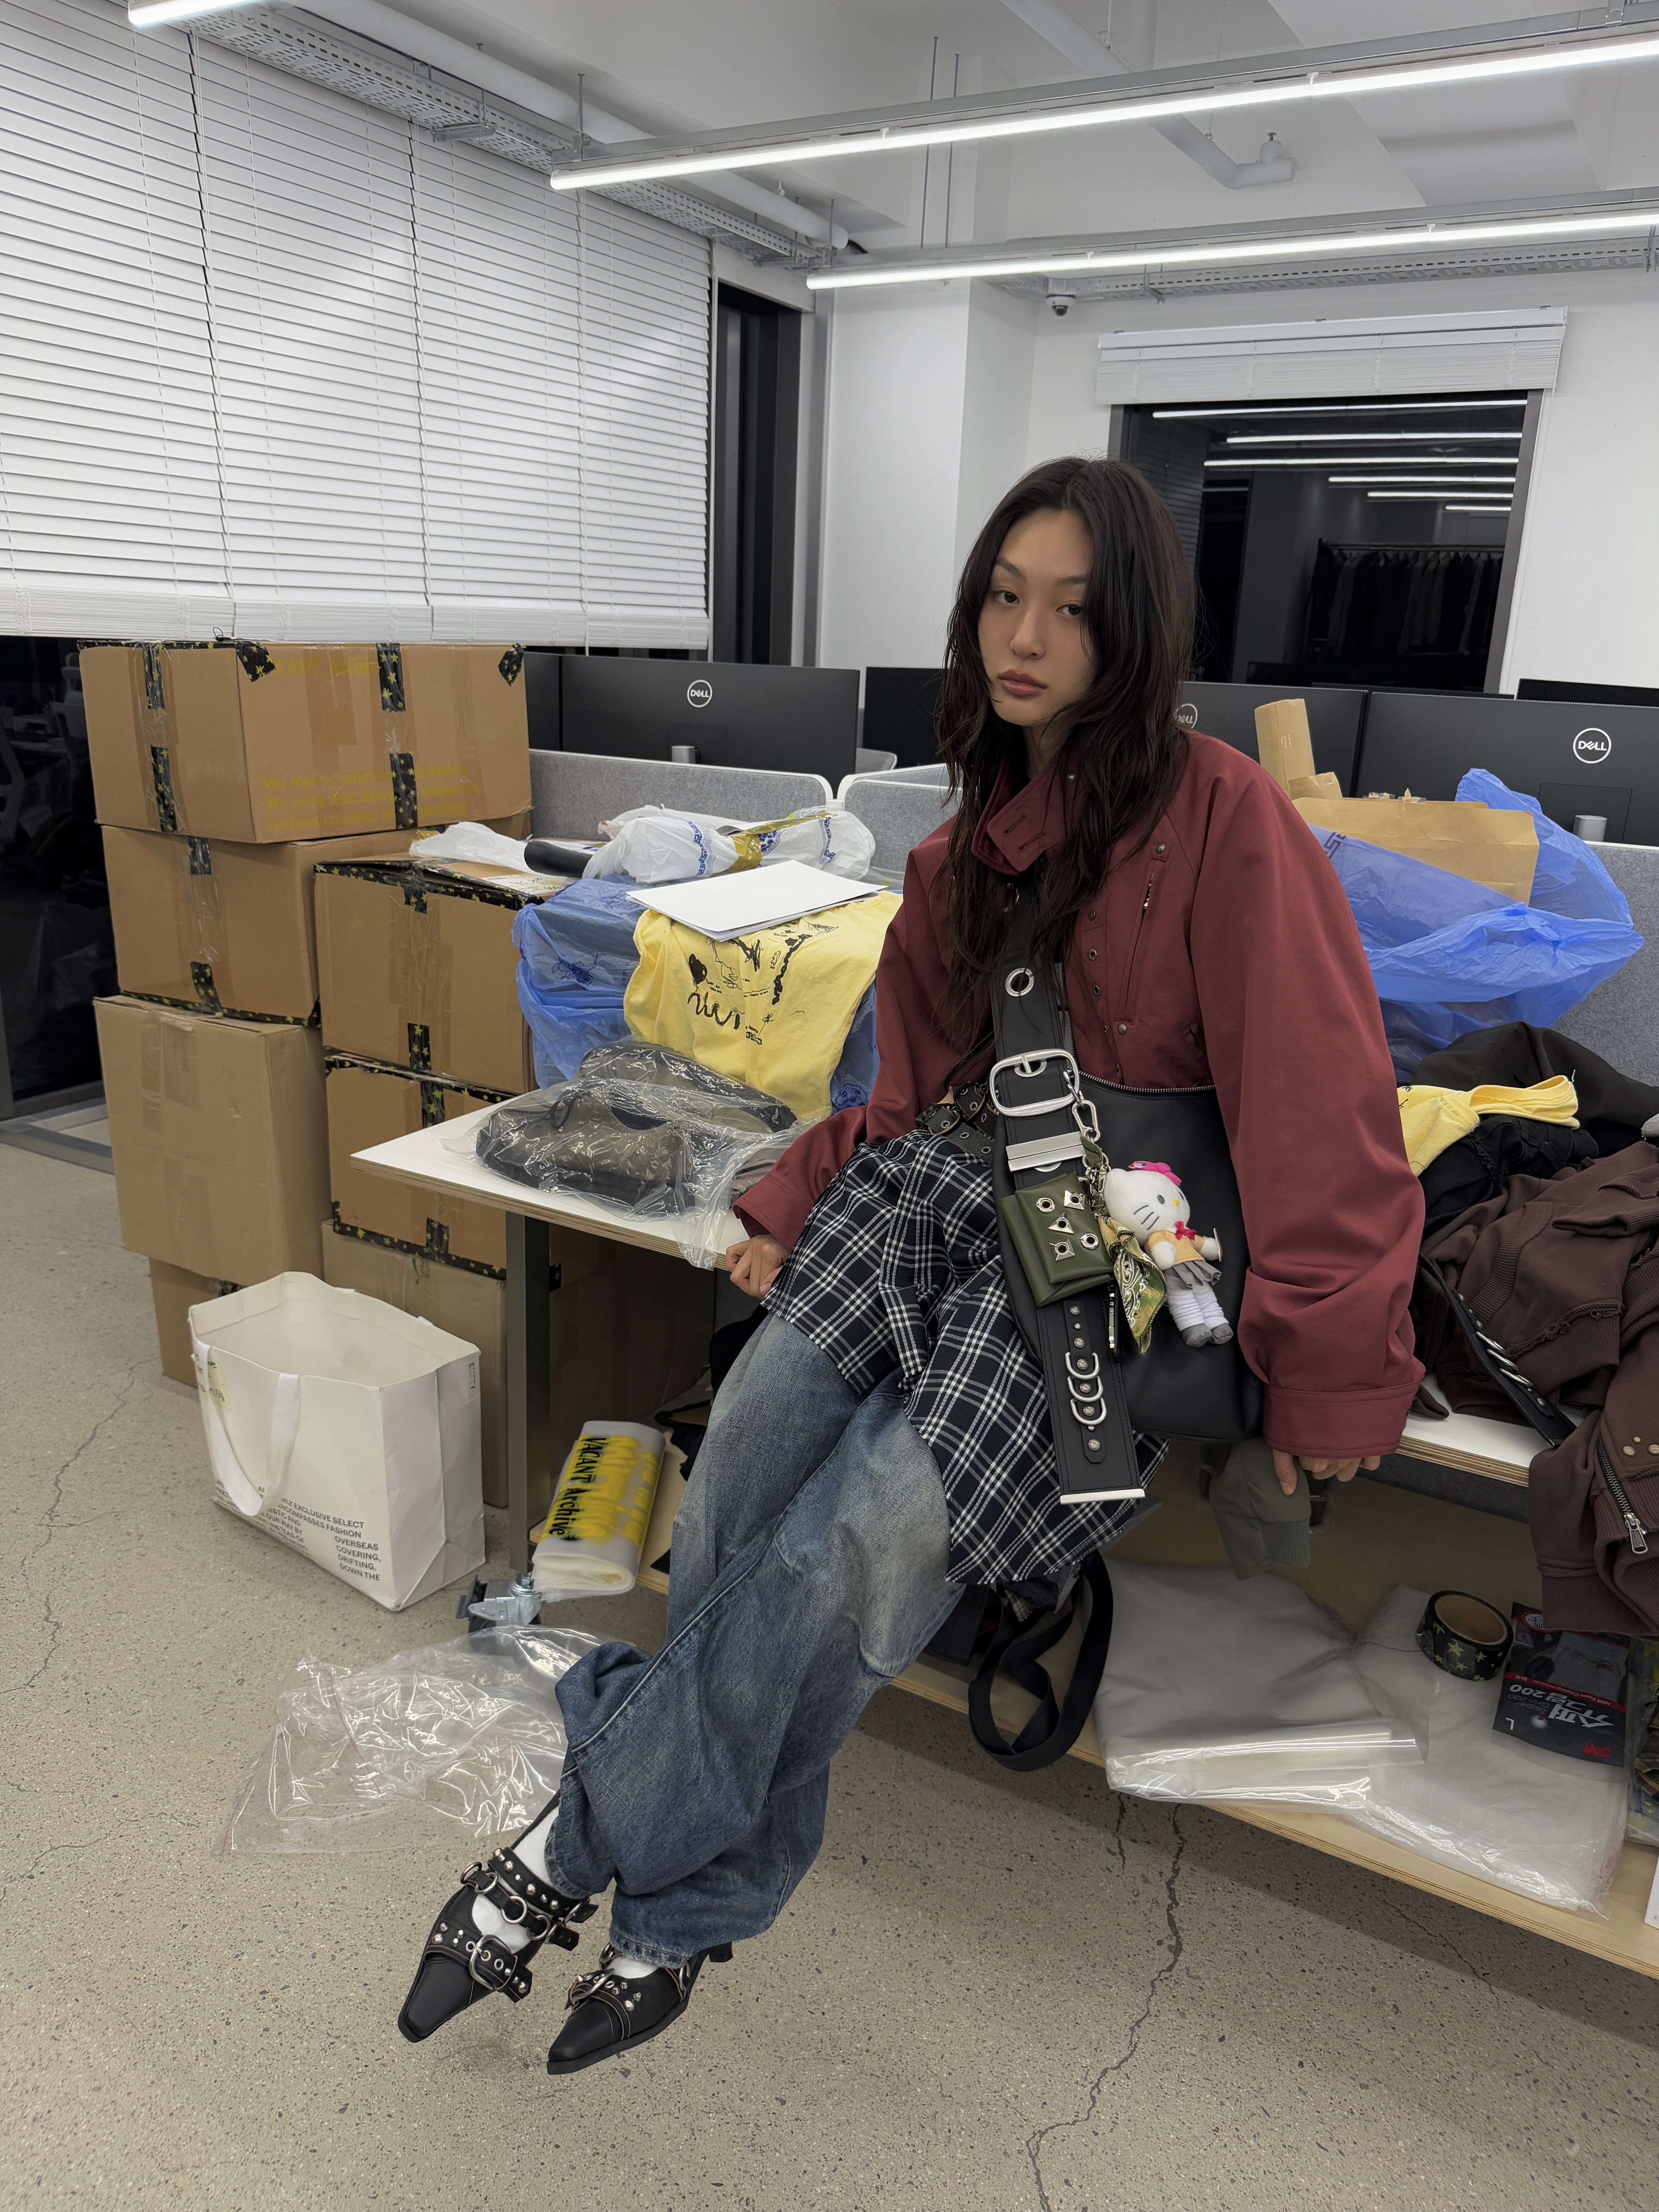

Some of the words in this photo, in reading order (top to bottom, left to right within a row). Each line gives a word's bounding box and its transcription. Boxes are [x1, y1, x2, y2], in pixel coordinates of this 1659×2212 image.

[272, 656, 321, 676] CANT
[1578, 740, 1607, 751] DELL
[262, 776, 285, 790] We
[264, 797, 287, 811] We
[292, 796, 326, 809] hope
[267, 817, 319, 831] clothes
[417, 803, 466, 818] pending
[571, 1437, 608, 1482] VACANT
[294, 1503, 331, 1522] EXCLUSIVE
[333, 1517, 364, 1528] SELECT
[549, 1488, 591, 1535] Archive
[266, 1513, 280, 1523] OUR
[281, 1519, 293, 1530] WAY
[295, 1527, 302, 1535] BY
[336, 1545, 381, 1562] COVERING,
[288, 1515, 301, 1526] AND
[335, 1536, 379, 1551] OVERSEAS
[326, 1524, 361, 1538] FASHION
[338, 1554, 377, 1571] DRIFTING,
[340, 1563, 363, 1577] DOWN
[364, 1571, 381, 1581] THE
[1507, 1694, 1528, 1702] 200
[1510, 1684, 1547, 1698] 200
[1515, 1701, 1546, 1714] Super
[1528, 1698, 1550, 1708] Grip
[1505, 1717, 1515, 1730] L
[1548, 1704, 1615, 1728] 슈퍼
[1583, 1743, 1612, 1758] 3M
